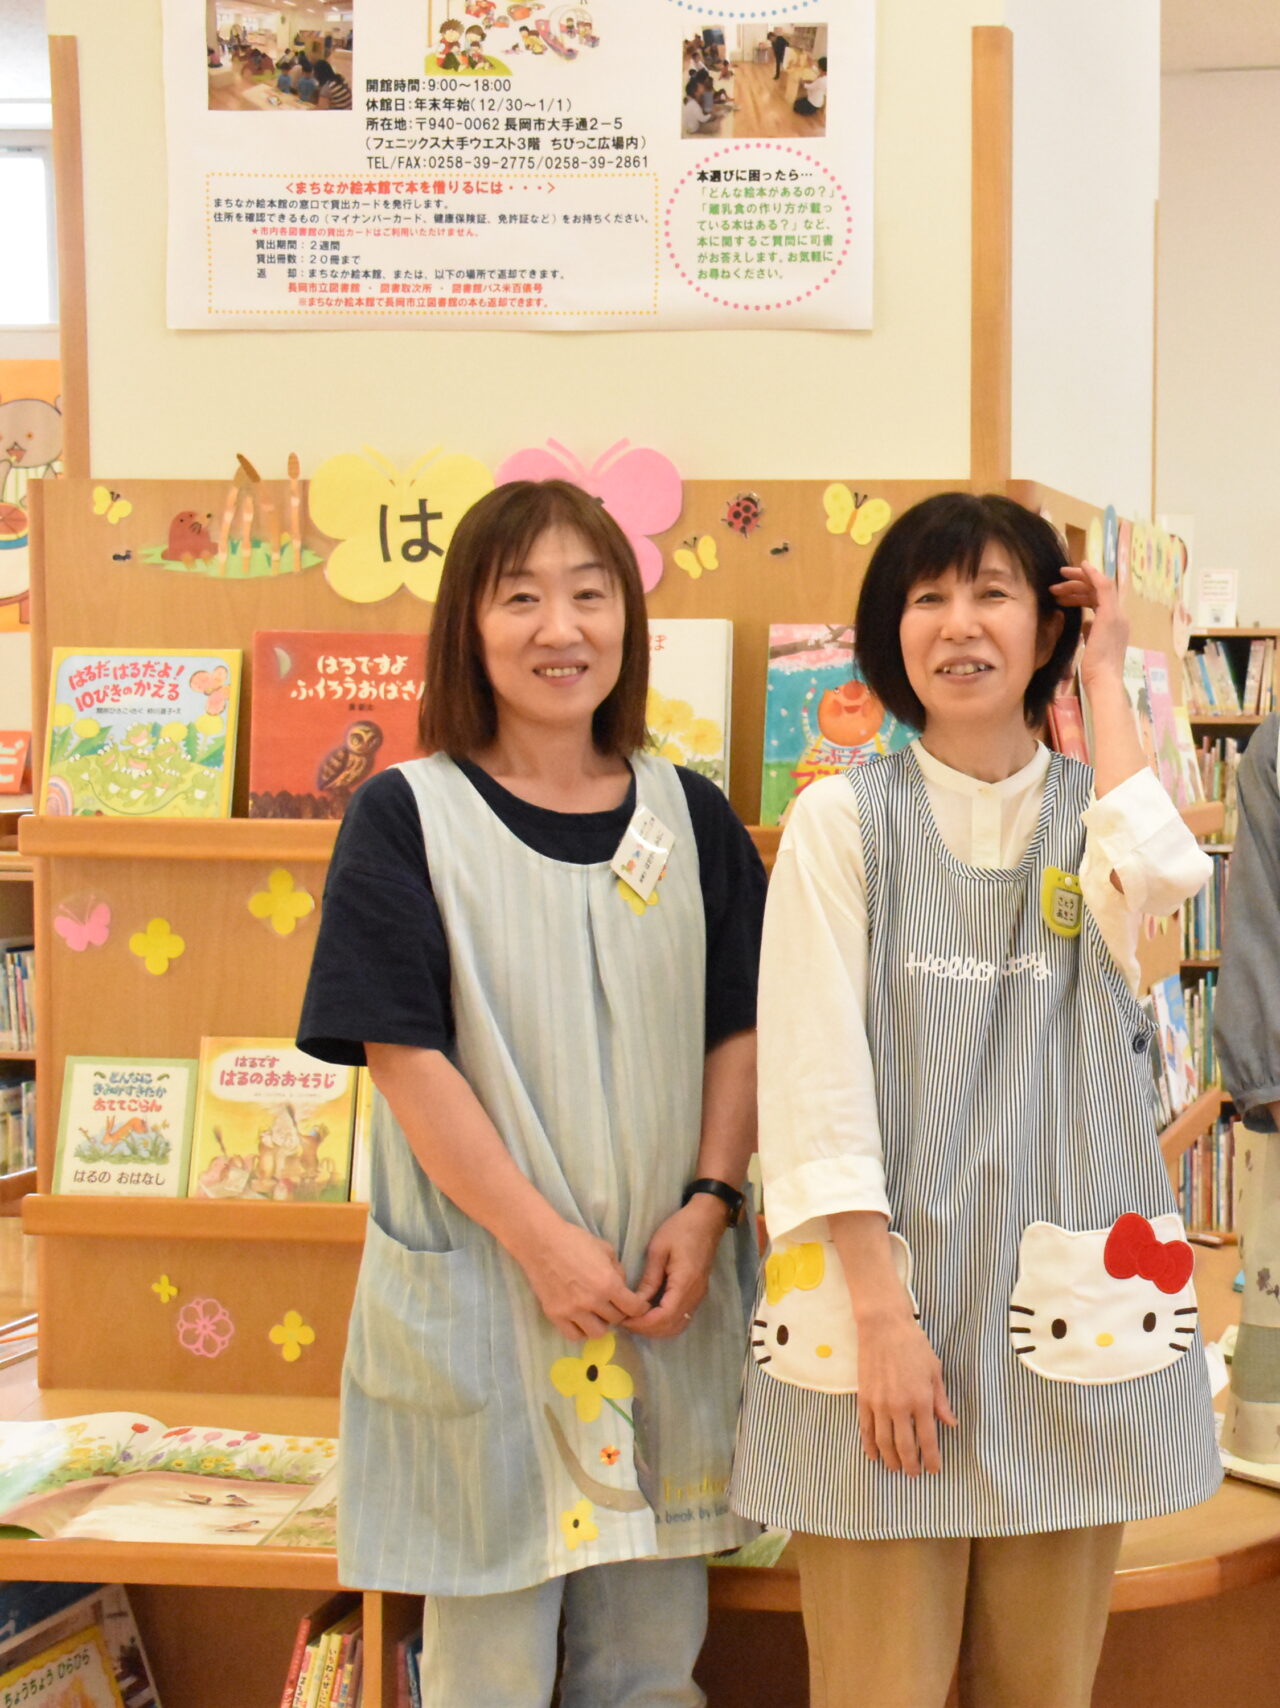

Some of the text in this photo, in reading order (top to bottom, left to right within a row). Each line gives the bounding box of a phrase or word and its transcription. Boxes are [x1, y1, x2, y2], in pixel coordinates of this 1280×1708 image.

[367, 156, 648, 170] TEL/FAX:0258-39-2775/0258-39-2861
[700, 185, 836, 199] 「どんな絵本があるの？」
[697, 218, 831, 231] ている本はある？」など、
[696, 234, 834, 247] 本に関するご質問に司書
[697, 250, 834, 264] がお答えします。お気軽に
[378, 498, 445, 563] は
[316, 653, 409, 675] はるですよ
[68, 659, 111, 691] はるだ
[904, 951, 996, 982] Hello
[234, 1055, 280, 1068] はるです
[219, 1069, 337, 1089] はるのおおそうじ
[73, 1169, 166, 1186] はるの おはなし
